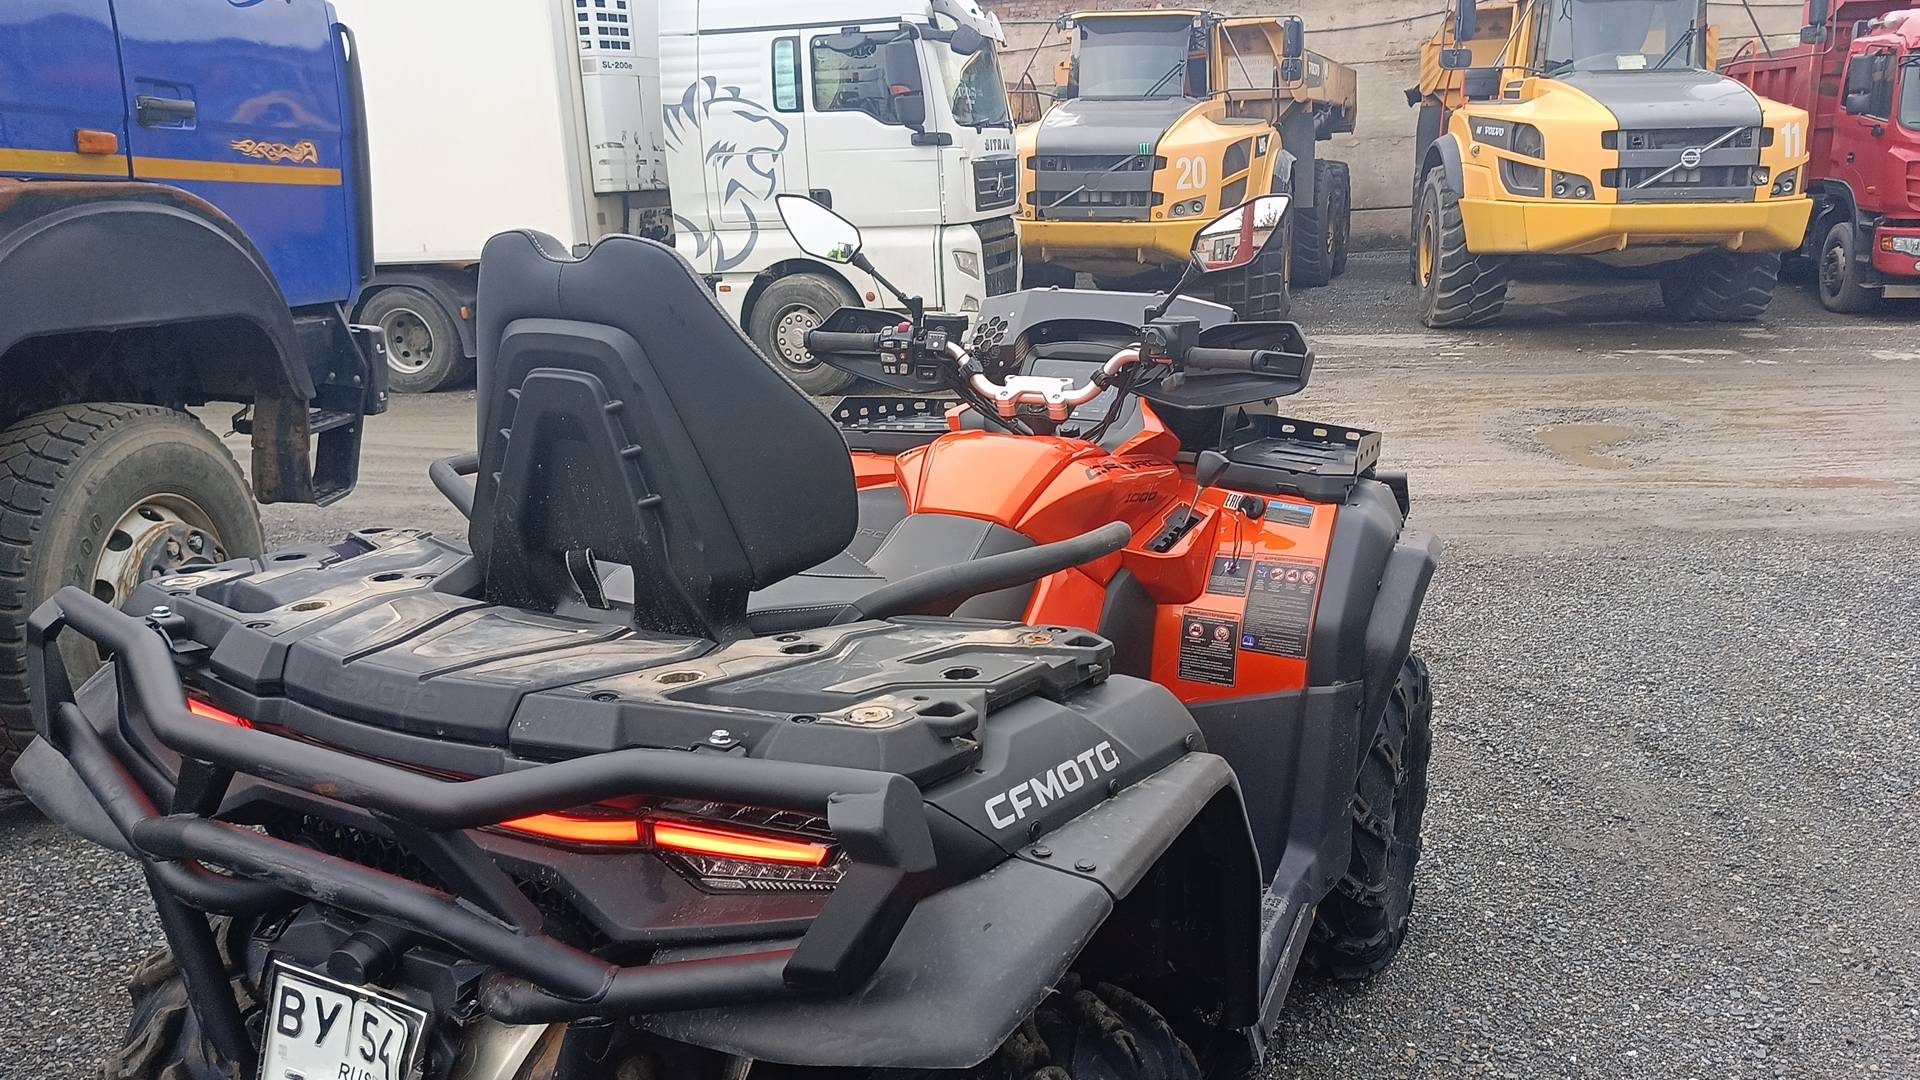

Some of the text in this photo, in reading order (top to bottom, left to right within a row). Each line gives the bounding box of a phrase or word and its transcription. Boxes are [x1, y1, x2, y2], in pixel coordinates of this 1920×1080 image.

[601, 60, 633, 70] SL-200e
[1484, 126, 1504, 137] VOLVO
[1781, 122, 1800, 158] 11
[1176, 156, 1207, 190] 20
[1124, 491, 1159, 504] 1000
[984, 740, 1121, 830] CFMOTO
